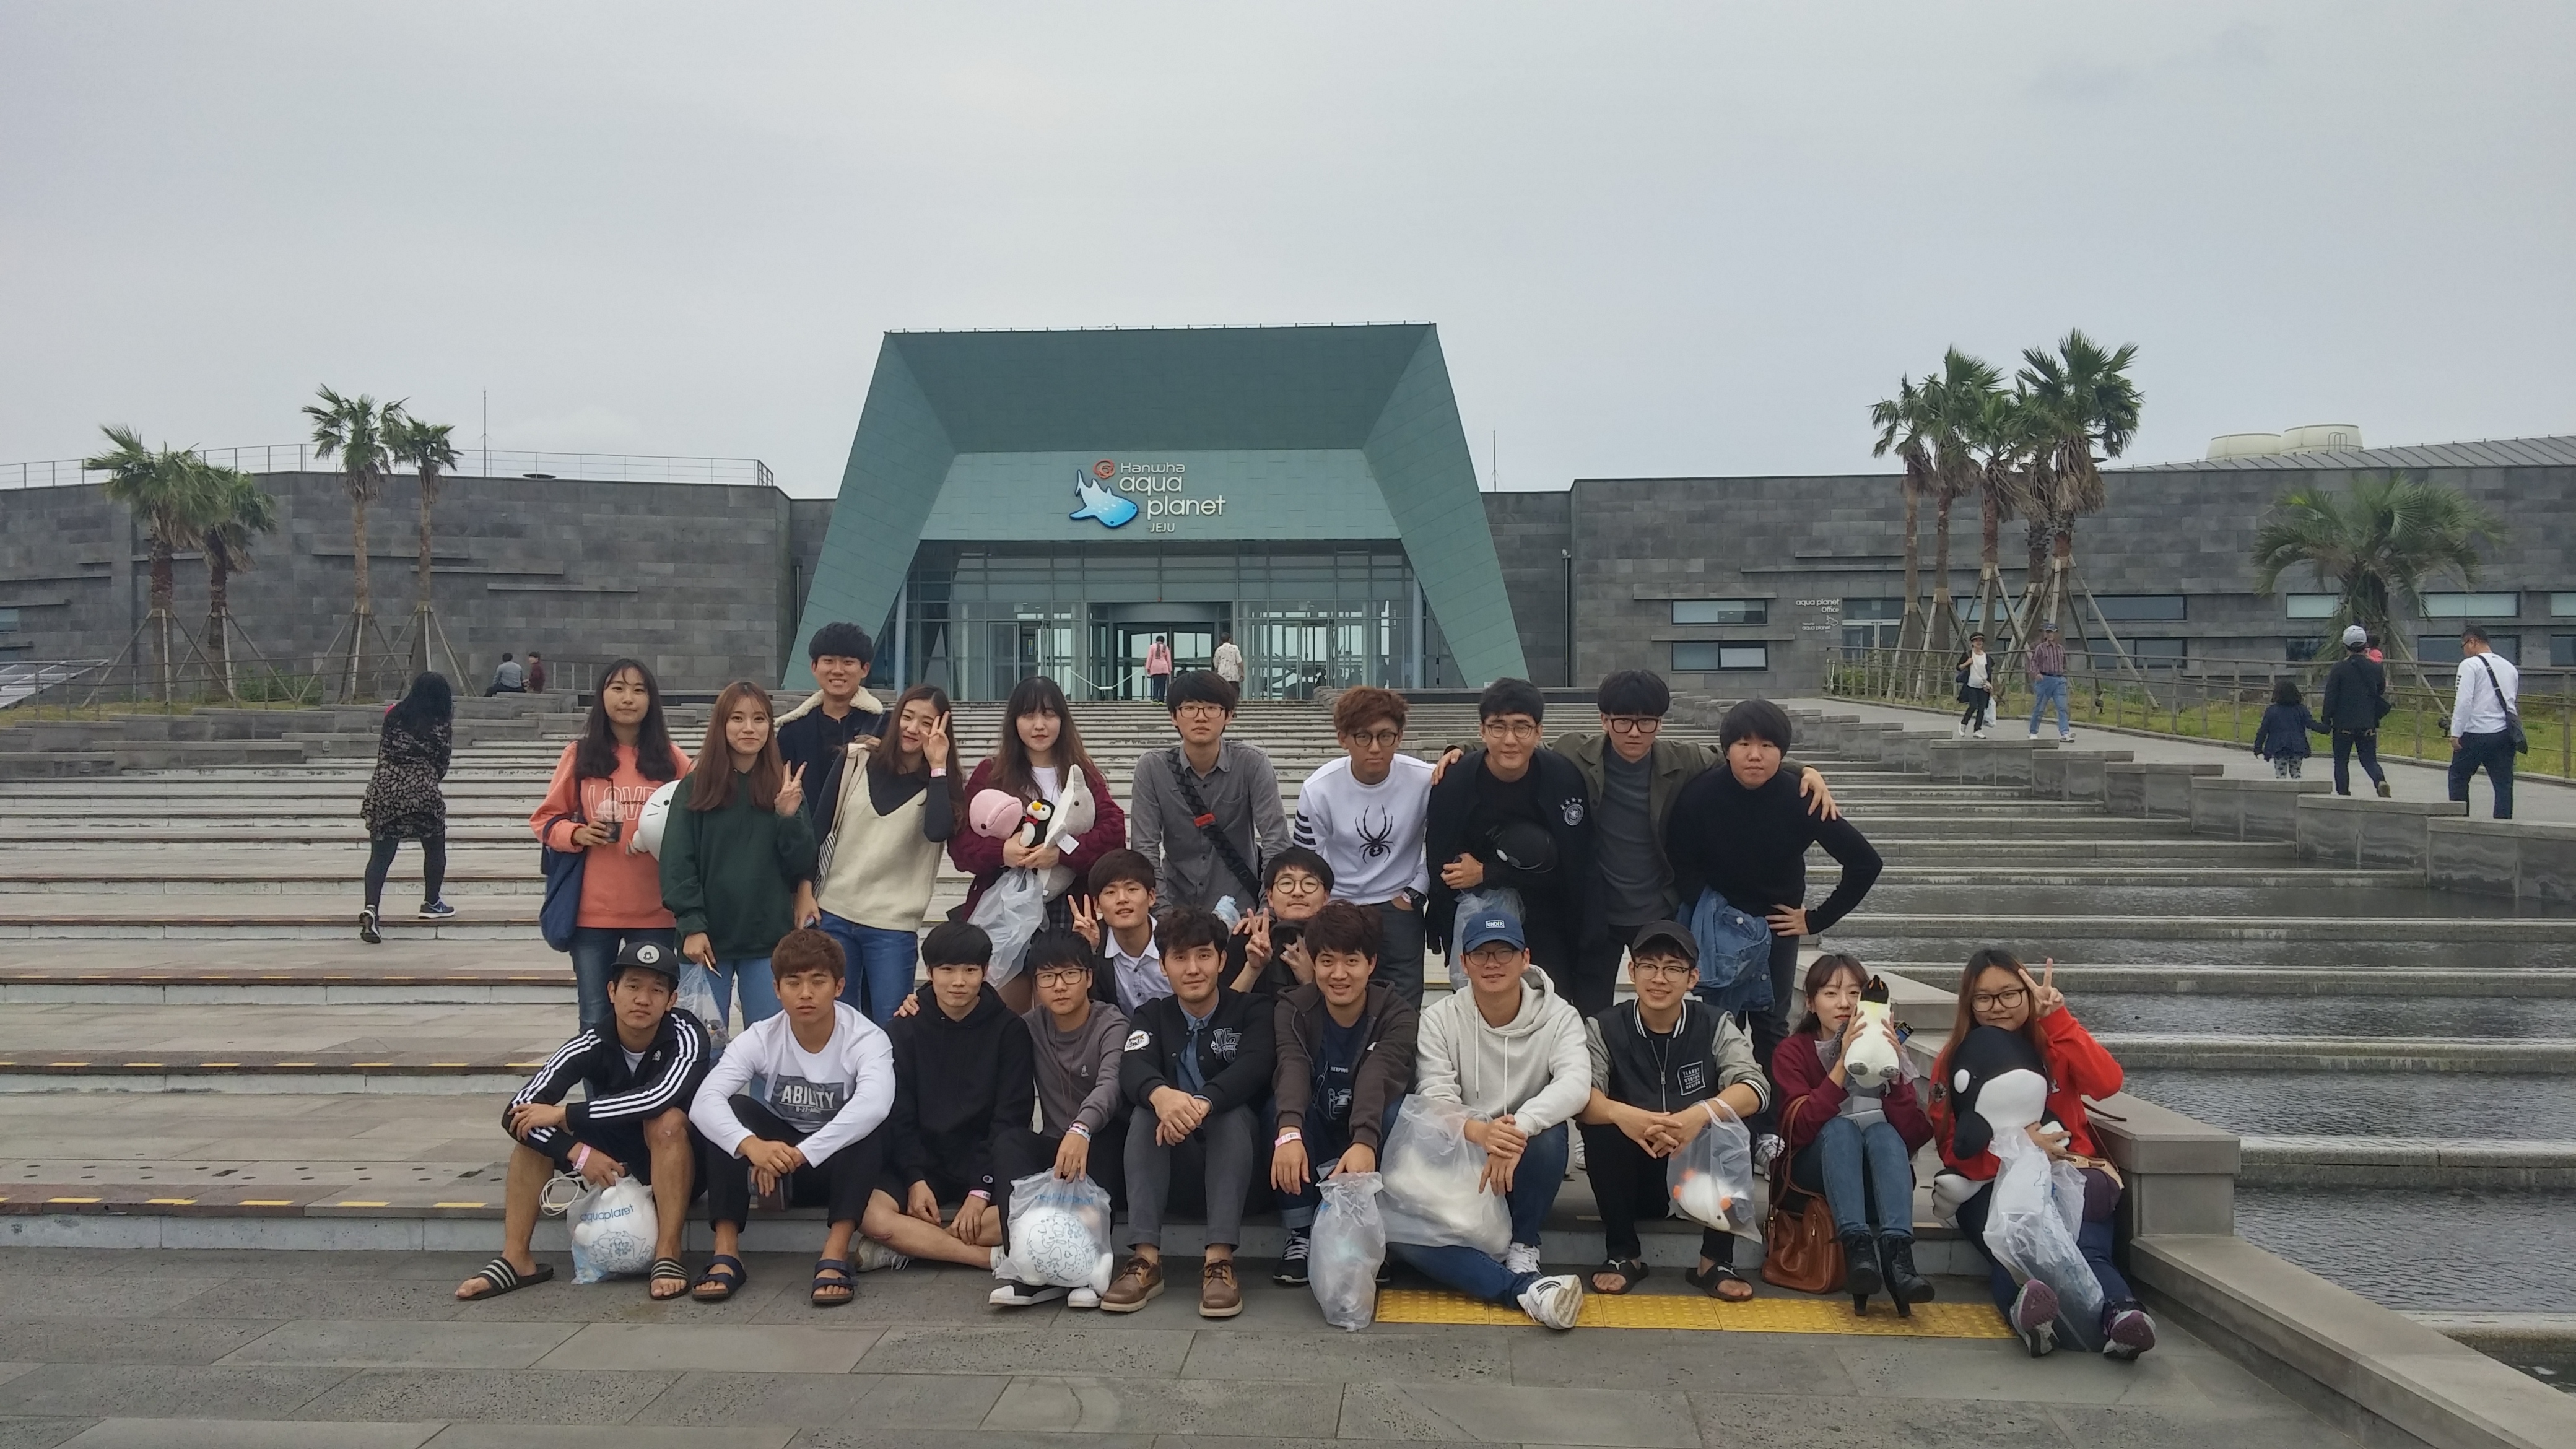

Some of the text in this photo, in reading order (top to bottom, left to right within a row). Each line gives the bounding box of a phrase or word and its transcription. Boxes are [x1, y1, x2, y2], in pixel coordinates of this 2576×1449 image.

[1120, 462, 1185, 474] Hanwha
[1119, 476, 1182, 497] aqua
[1147, 495, 1226, 520] planet
[1149, 523, 1175, 533] JEJU
[1816, 598, 1840, 607] planet
[781, 1085, 835, 1108] ABILITY
